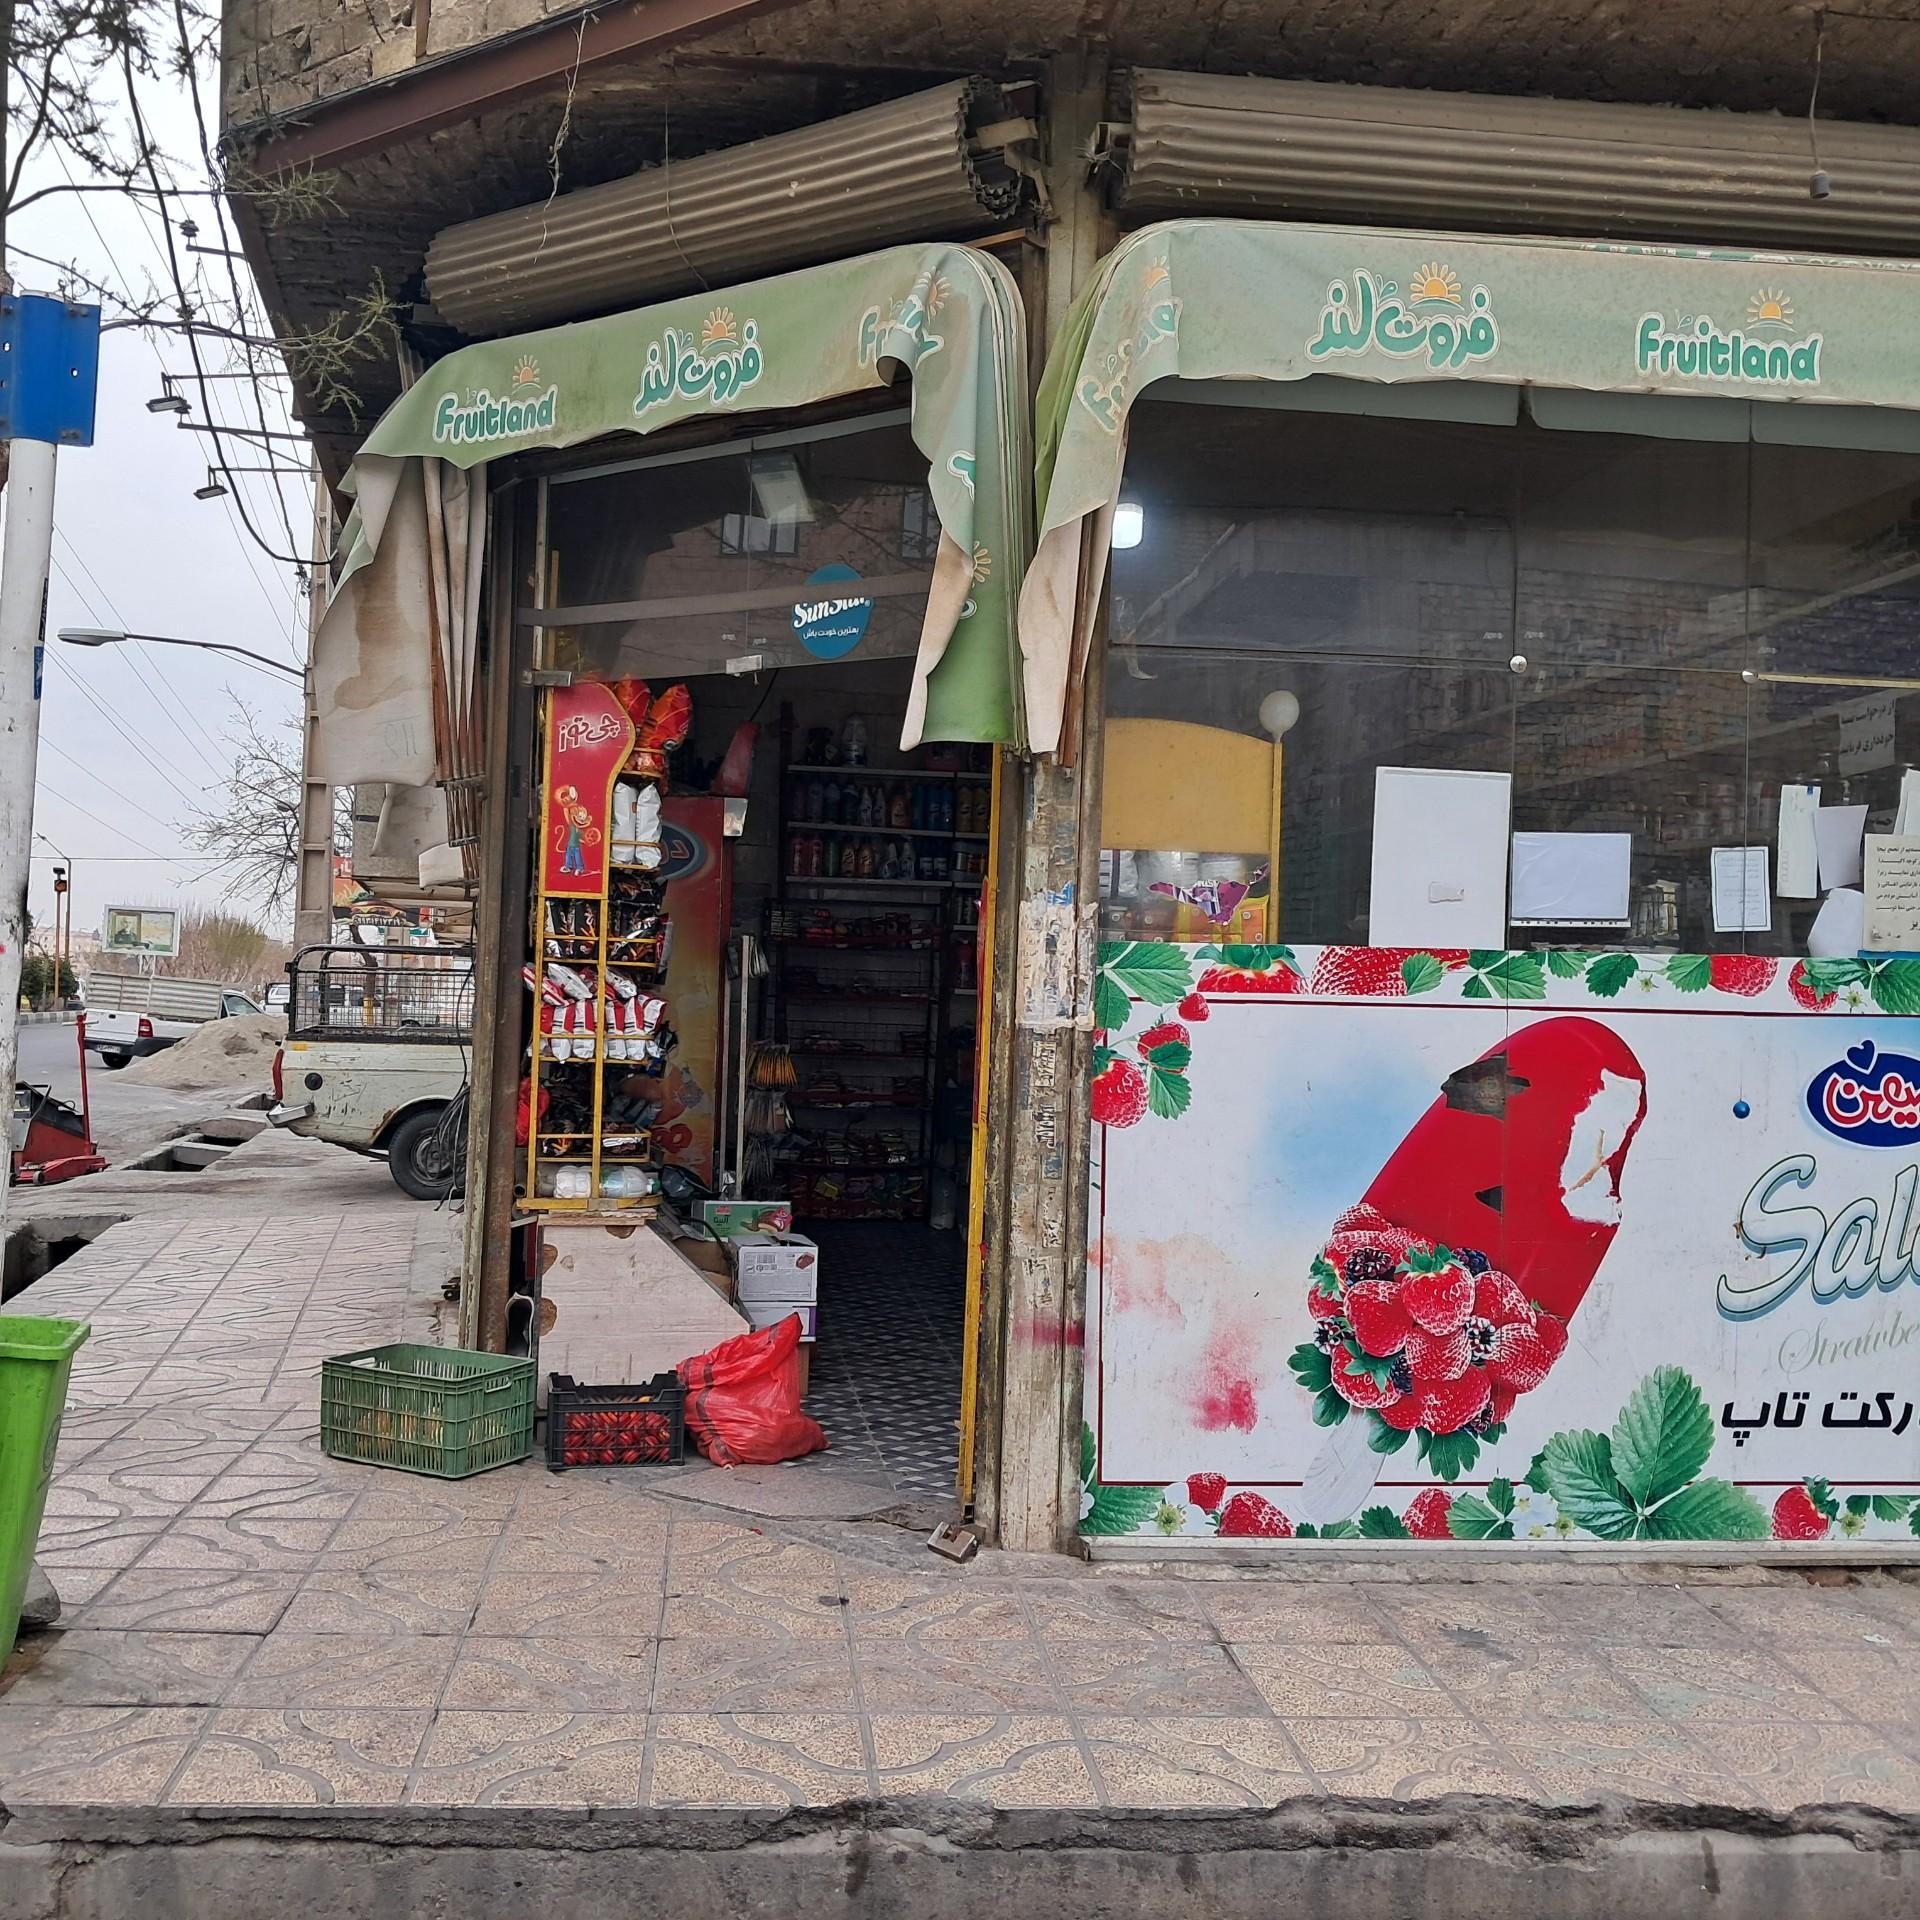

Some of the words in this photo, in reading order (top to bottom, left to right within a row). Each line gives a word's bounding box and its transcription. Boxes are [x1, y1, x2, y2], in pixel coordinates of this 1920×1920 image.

[1635, 312, 1824, 384] Fruitland
[433, 384, 558, 444] Fruitland
[1823, 1073, 1920, 1128] یهن
[1717, 1154, 1920, 1321] Sal
[1721, 1392, 1811, 1447] تاپ
[1822, 1392, 1920, 1436] رکت
